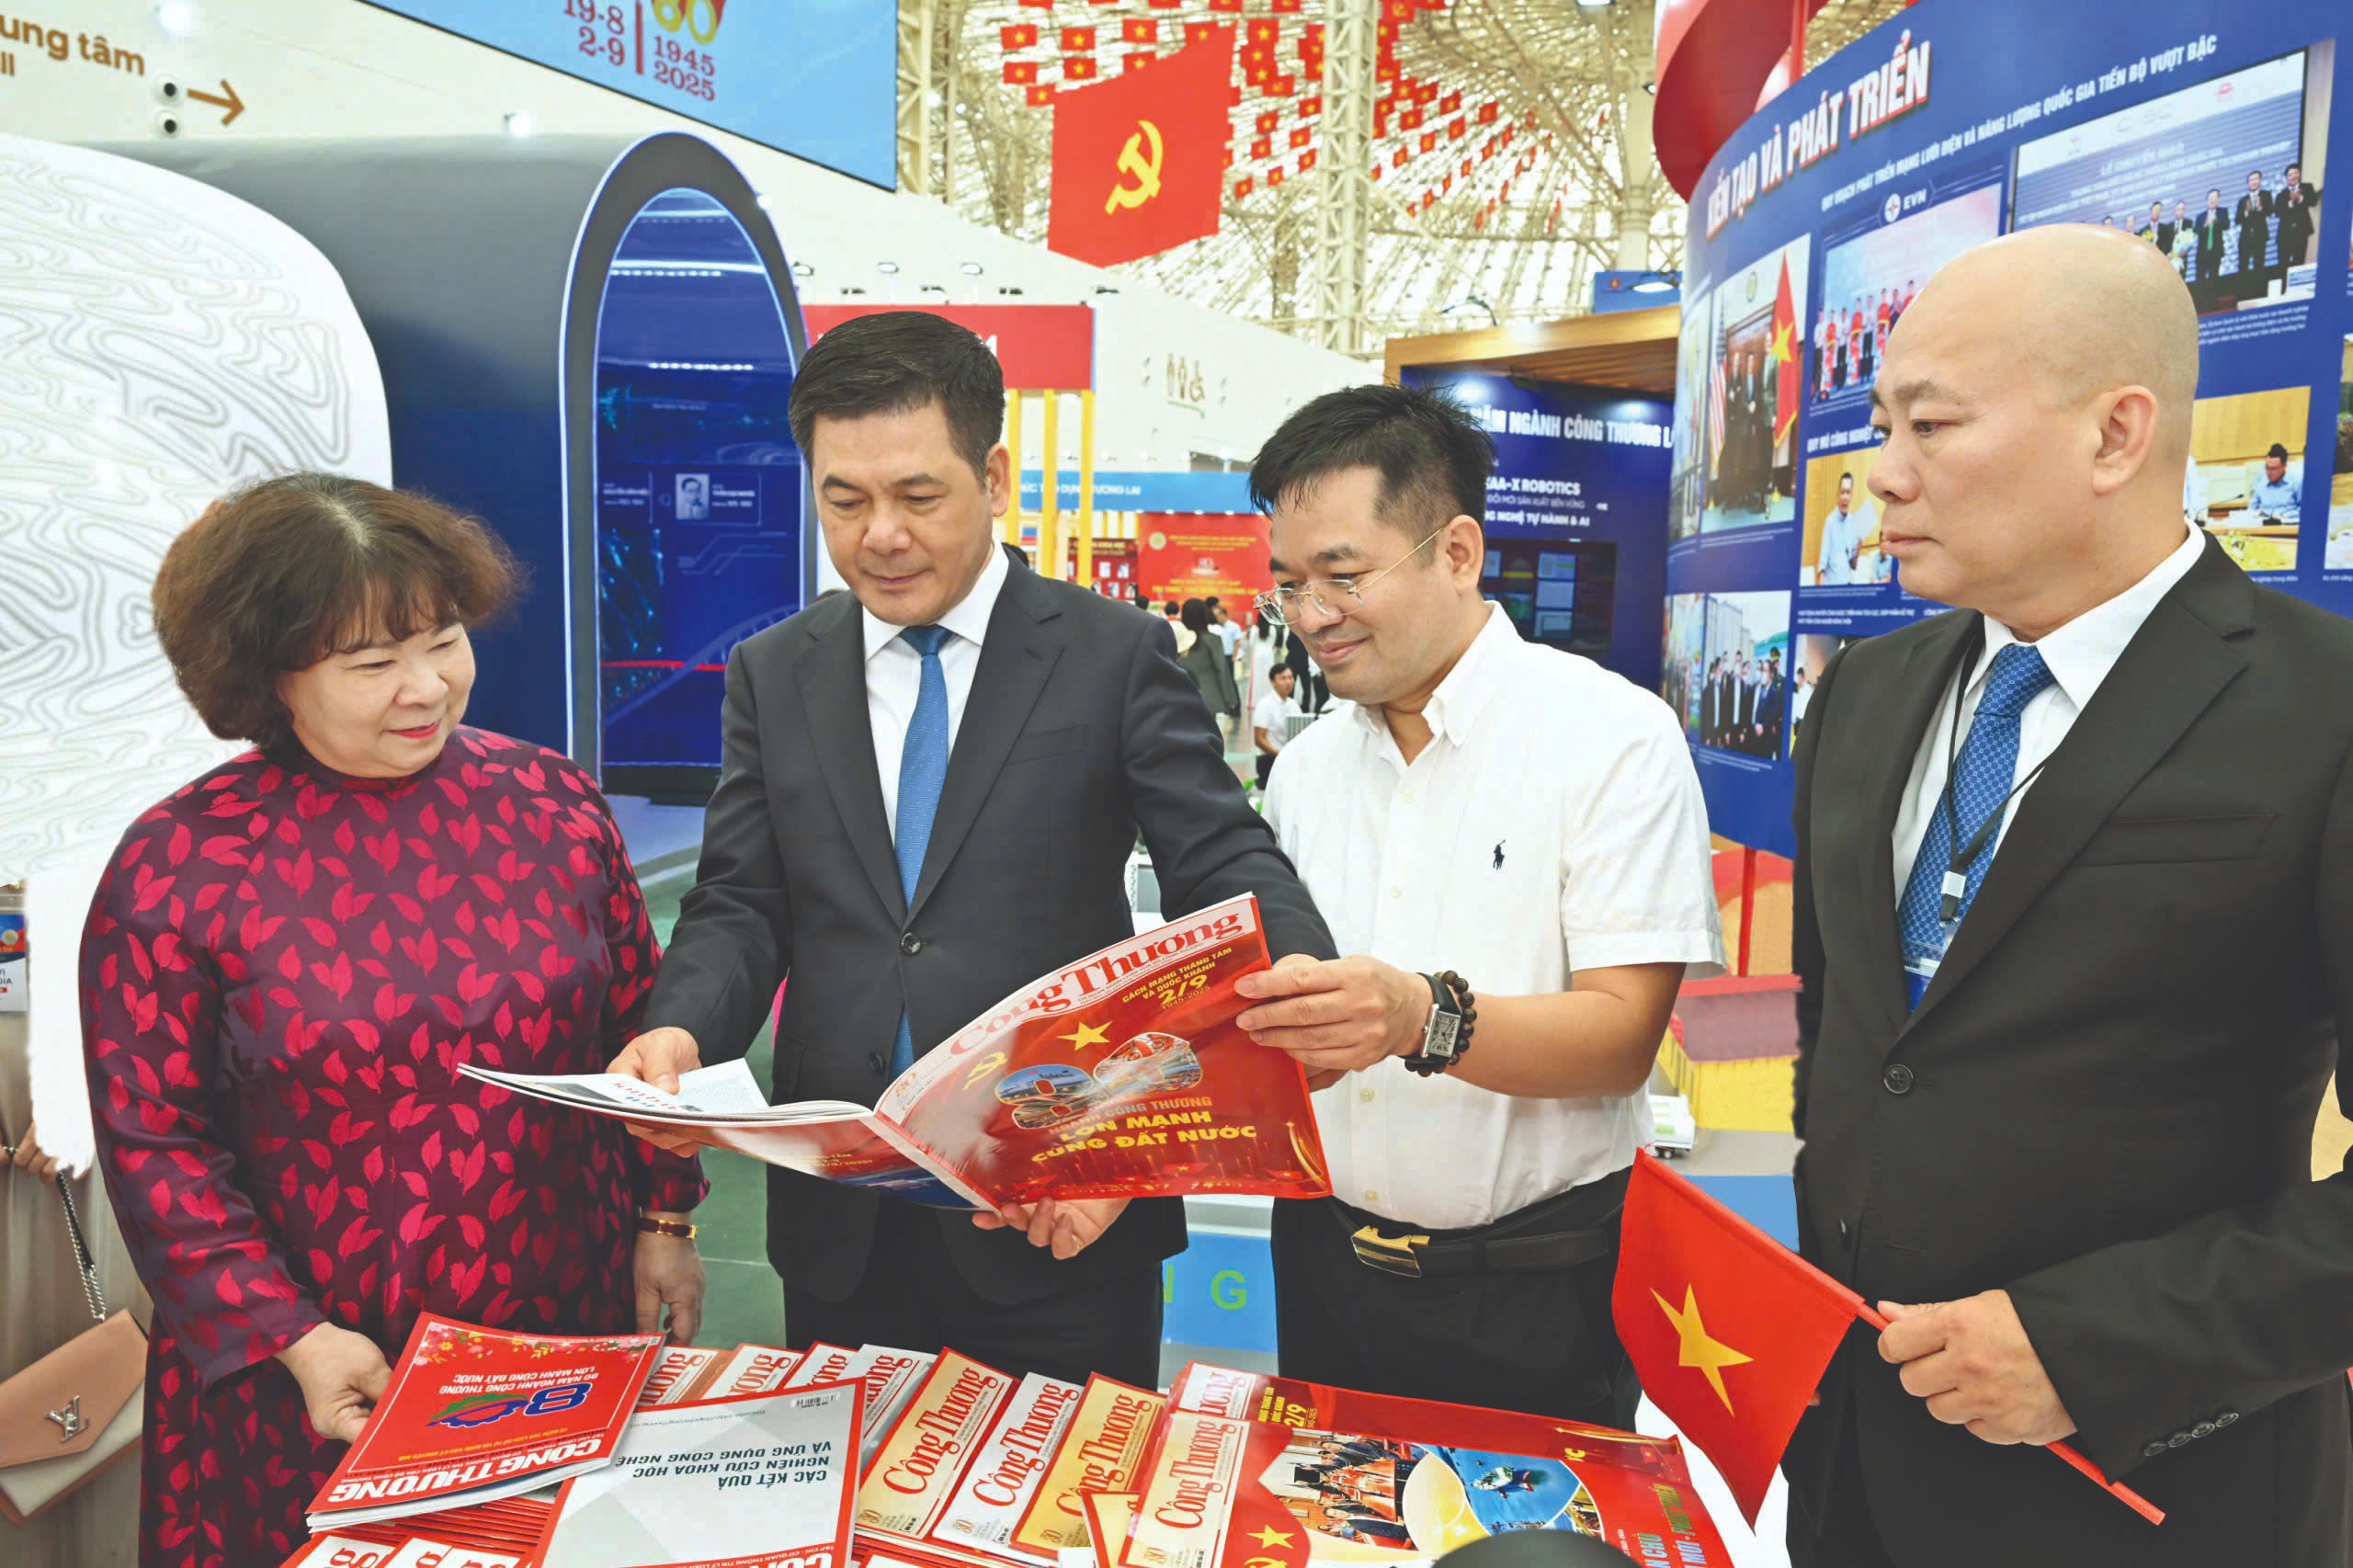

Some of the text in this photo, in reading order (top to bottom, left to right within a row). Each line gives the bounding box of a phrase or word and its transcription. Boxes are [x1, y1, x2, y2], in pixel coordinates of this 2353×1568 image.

[78, 33, 144, 75] tâm
[654, 36, 715, 76] 1945
[654, 61, 715, 101] 2025
[2043, 85, 2074, 115] QUỐC
[2075, 80, 2096, 102] GIA
[2098, 66, 2126, 93] TIẾN
[2129, 57, 2146, 83] BỘ
[2150, 46, 2184, 72] VƯỢT
[2187, 35, 2217, 61] BẬC
[1732, 152, 1757, 220] TẠO
[1761, 124, 1782, 192] VÀ
[1787, 90, 1844, 176] PHÁT
[1848, 28, 1930, 139] TRIỂN
[1903, 188, 1927, 210] EVN
[1509, 409, 1561, 437] NGÀNH
[1564, 415, 1603, 441] CÔNG
[1521, 479, 1581, 495] ROBOTICS
[1061, 912, 1243, 996] Thương
[1149, 971, 1176, 988] MẠNG
[1178, 955, 1210, 972] THÁNG
[1212, 947, 1233, 960] TÁM
[1142, 989, 1155, 1000] VÀ
[1157, 977, 1182, 994] QUỐC
[1158, 974, 1207, 1006] 2/9
[1149, 1096, 1212, 1111] THƯƠNG
[1115, 1131, 1168, 1148] ĐẤT
[1176, 1124, 1257, 1142] NƯỚC
[1126, 1111, 1212, 1130] MẠNH
[439, 1385, 483, 1394] THƯƠNG
[453, 1374, 484, 1383] NƯỚC
[485, 1383, 515, 1393] CÔNG
[517, 1379, 554, 1390] NGÀNH
[540, 1369, 568, 1379] MẠNH
[557, 1375, 582, 1385] NĂM
[915, 1367, 999, 1437] Thương
[1284, 1403, 1307, 1426] 2/9
[1000, 1383, 1079, 1454] Thương
[1077, 1393, 1153, 1465] Thương
[496, 1439, 601, 1474] CÔNG
[616, 1441, 832, 1468] VÀ ỨNG DỤNG CÔNG NGHỆ
[632, 1456, 829, 1478] NGHIÊN CỨU KHOA HỌC
[883, 1432, 960, 1494] Công
[327, 1462, 493, 1503] THƯƠNG
[718, 1471, 826, 1491] CÁC KẾT QUẢ
[972, 1449, 1045, 1506] Công
[1154, 1419, 1236, 1528] Công Thương
